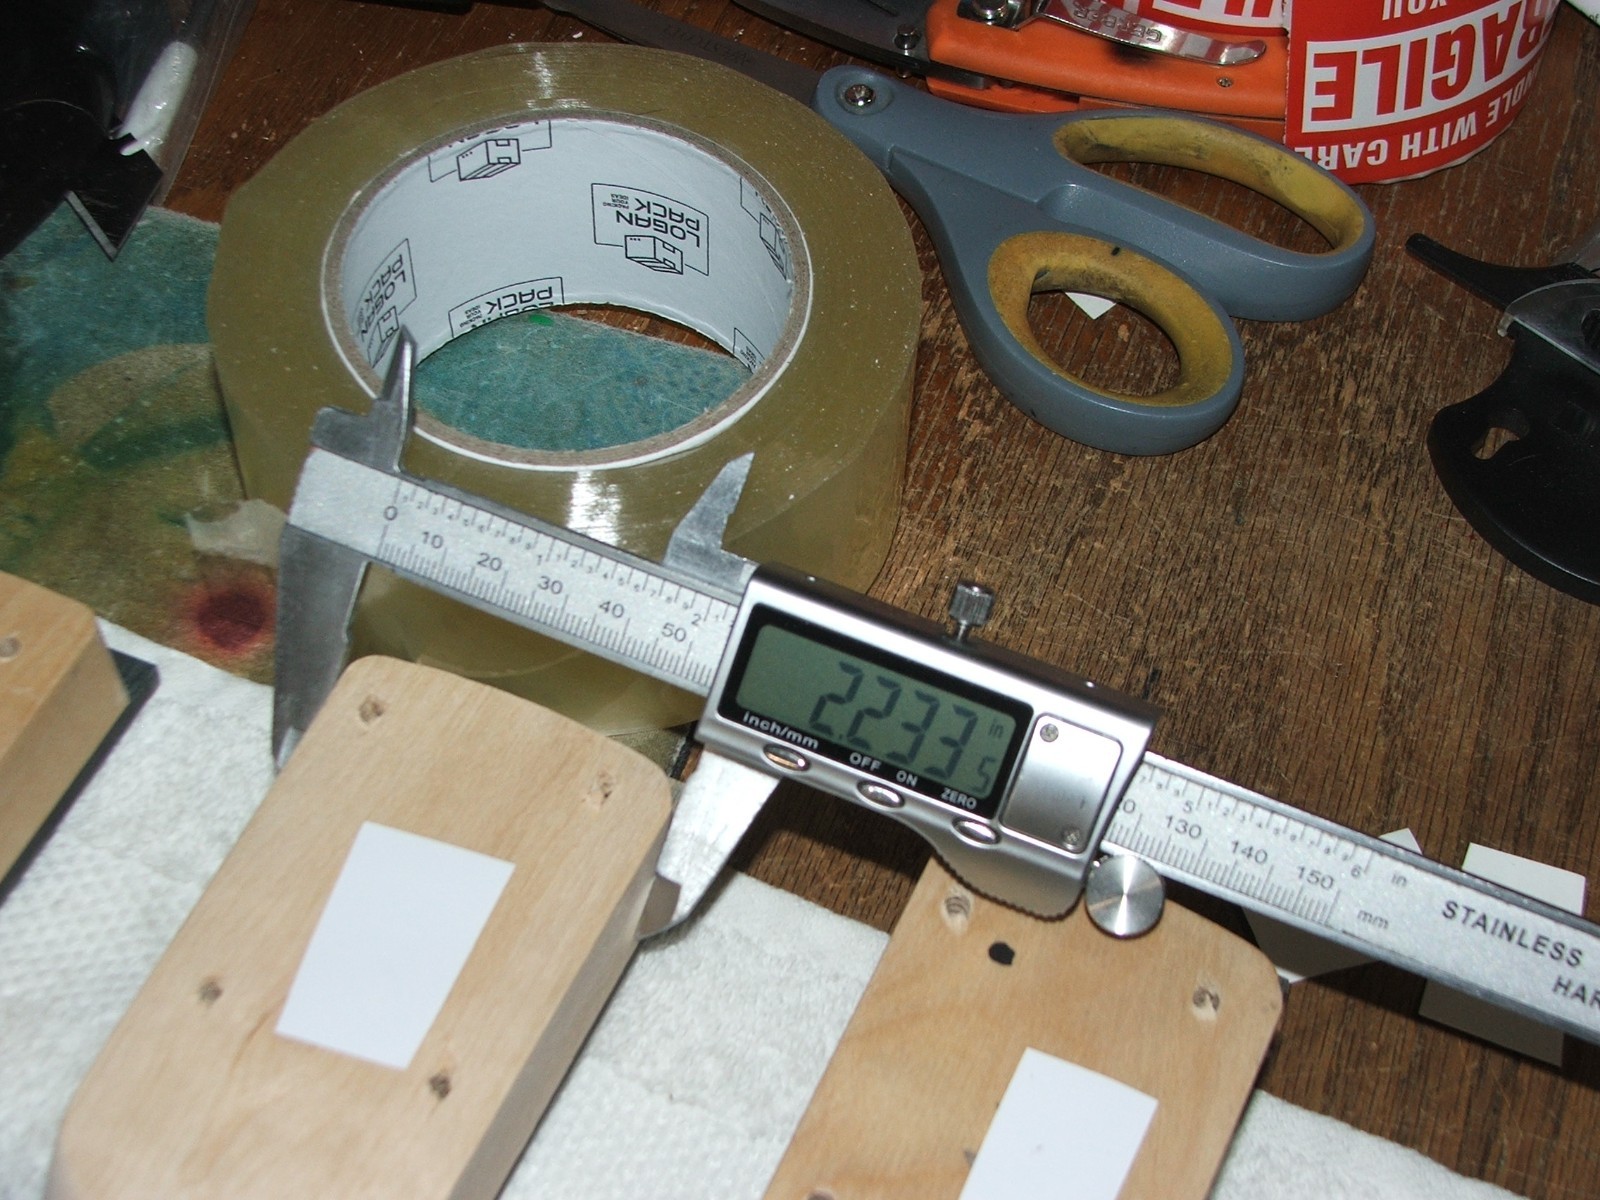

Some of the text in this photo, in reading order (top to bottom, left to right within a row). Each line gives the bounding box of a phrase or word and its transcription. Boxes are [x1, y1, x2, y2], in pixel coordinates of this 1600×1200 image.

[1310, 0, 1554, 122] RAGILE
[1400, 111, 1477, 161] WITH
[616, 210, 700, 248] LOGAN
[635, 197, 700, 231] PACK
[363, 254, 404, 310] PACK
[486, 287, 552, 315] PACK
[383, 505, 686, 642] 0 10 20 30 40 50
[691, 613, 702, 626] 2
[849, 752, 881, 773] OFF
[896, 770, 919, 787] ON
[941, 787, 977, 810] ZERO
[1182, 800, 1193, 813] 5
[1351, 865, 1362, 878] 6
[1391, 873, 1408, 888] in
[1165, 815, 1390, 929] 130 140 150 mm
[1442, 900, 1583, 968] STAINLESS
